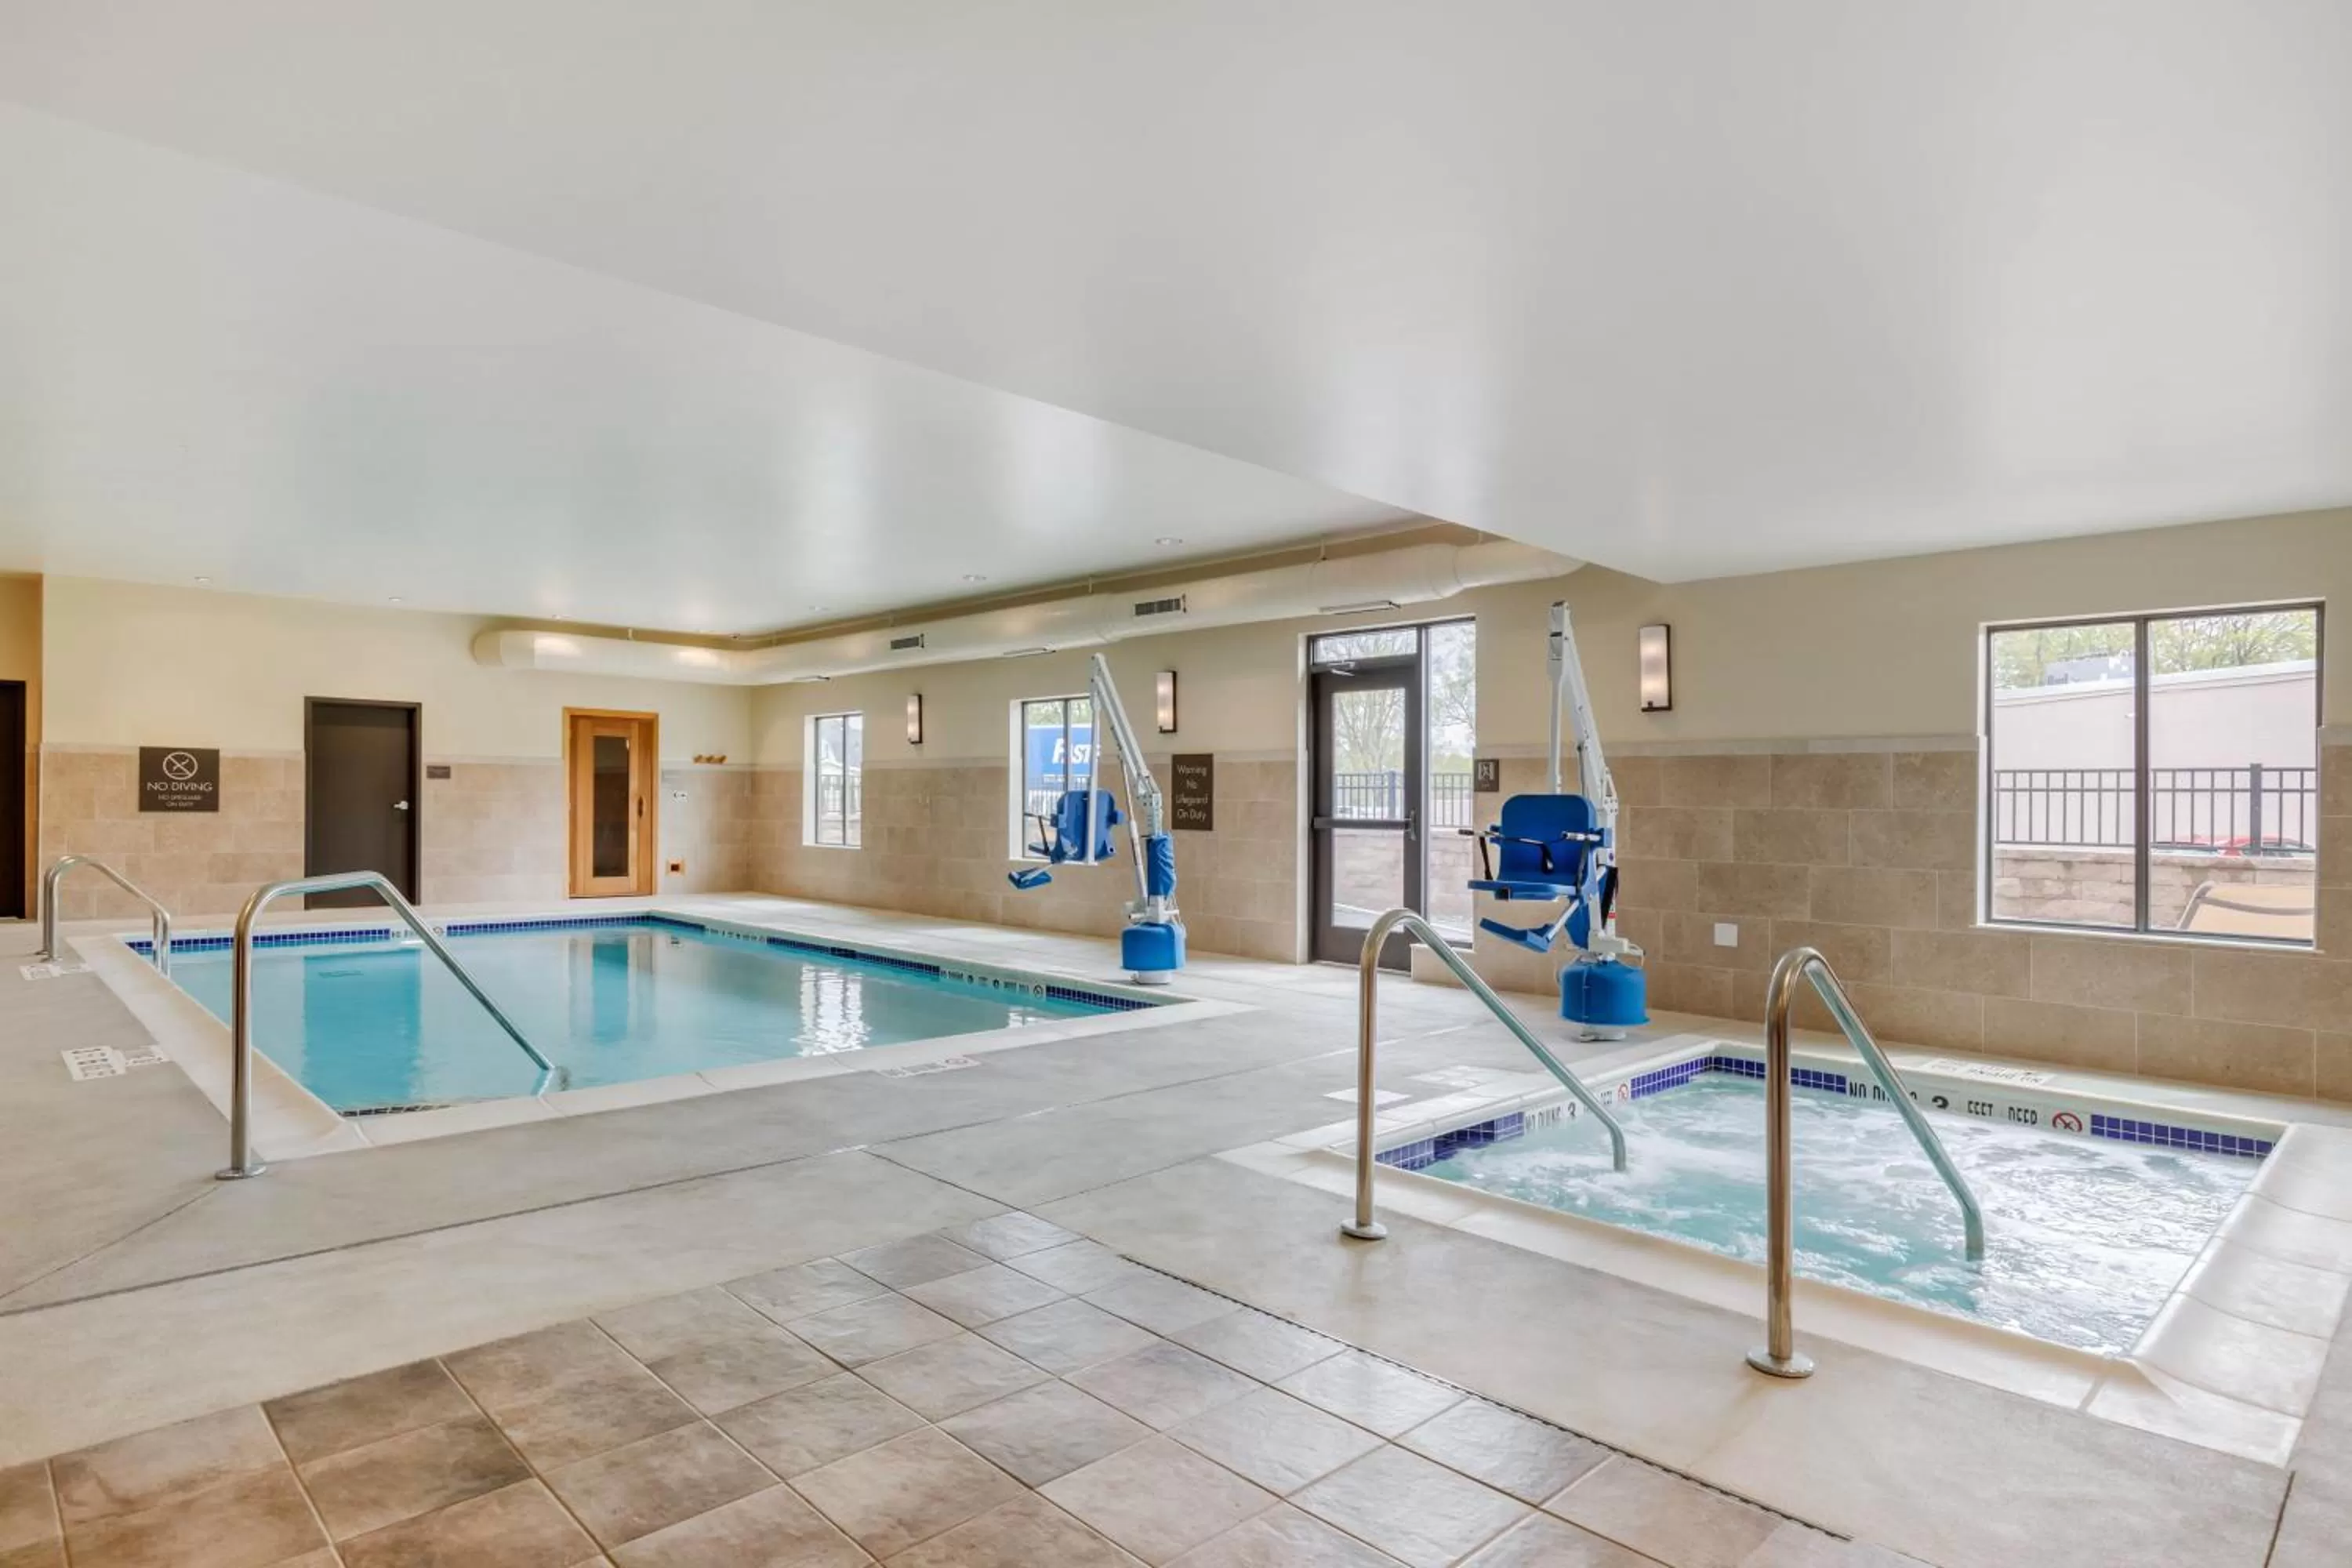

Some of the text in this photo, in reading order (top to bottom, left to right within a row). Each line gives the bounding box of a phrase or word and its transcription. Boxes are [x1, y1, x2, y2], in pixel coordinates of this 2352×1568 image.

[1177, 764, 1207, 777] Warning
[147, 782, 213, 792] NO DIVING
[1186, 779, 1198, 789] No
[1175, 793, 1208, 807] Lifeguard
[1177, 808, 1207, 822] On Duty
